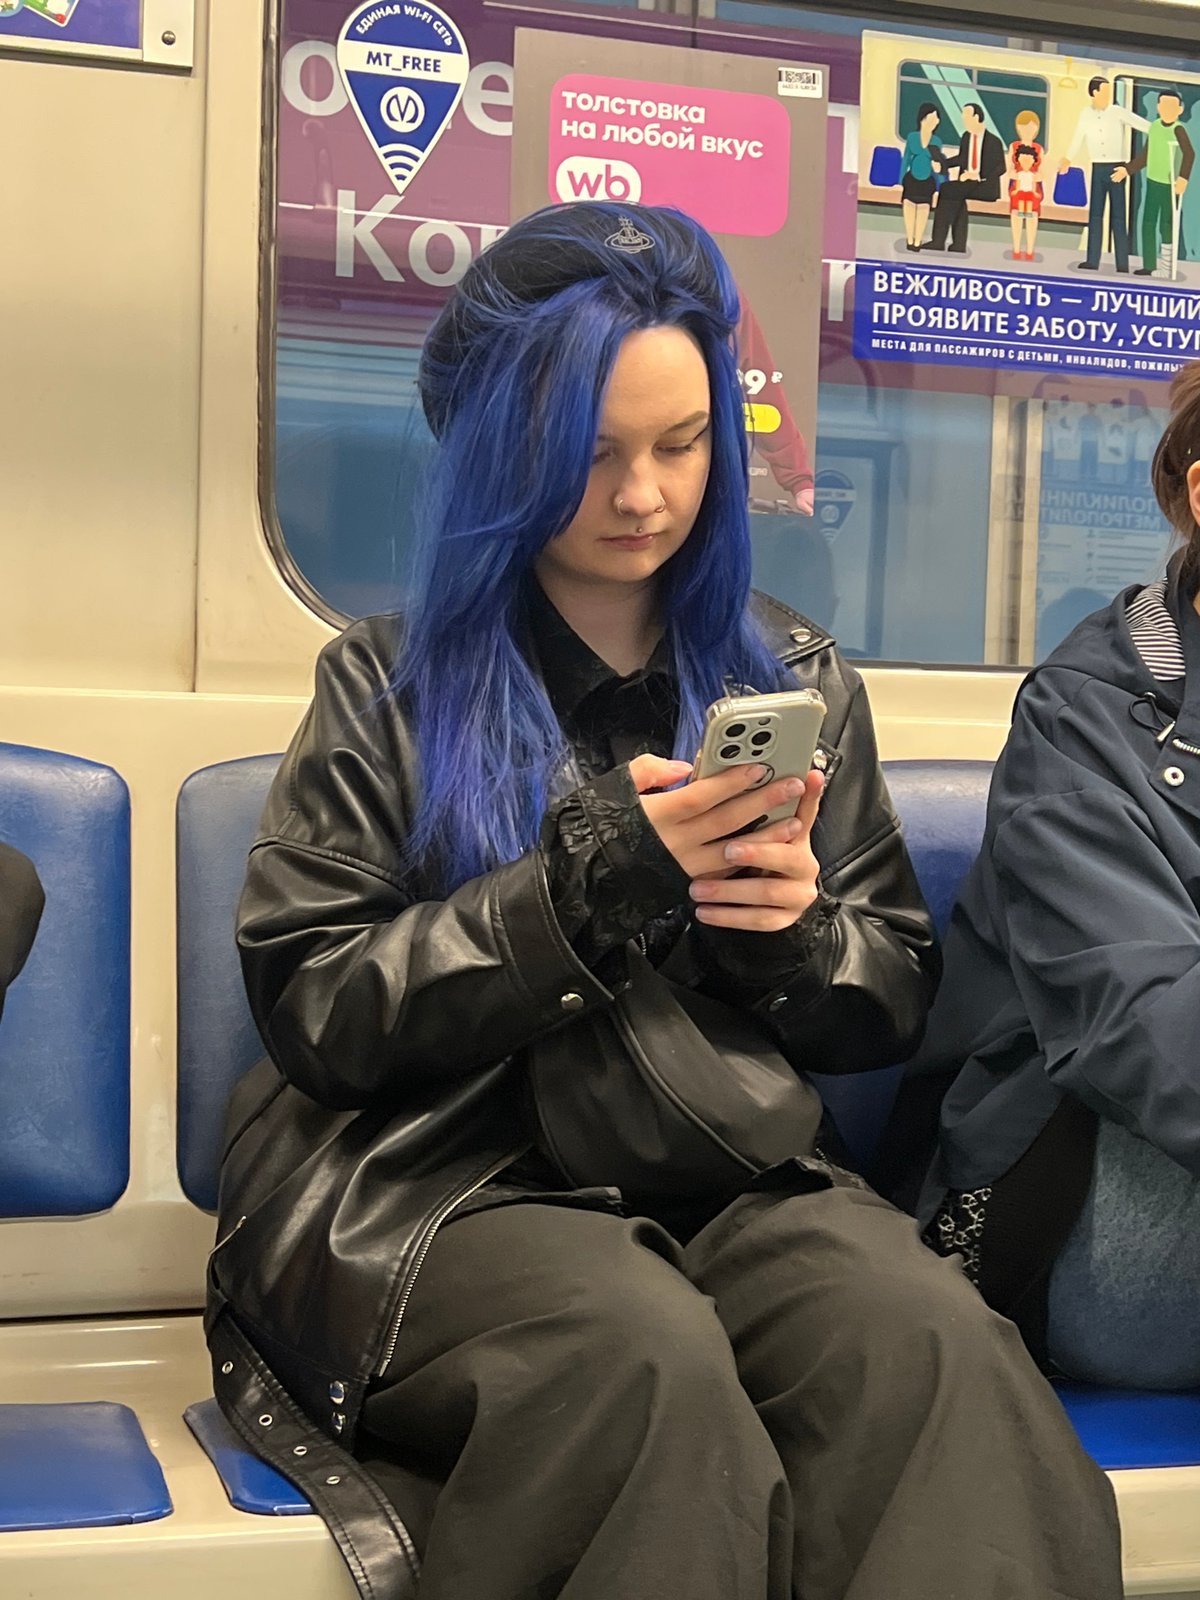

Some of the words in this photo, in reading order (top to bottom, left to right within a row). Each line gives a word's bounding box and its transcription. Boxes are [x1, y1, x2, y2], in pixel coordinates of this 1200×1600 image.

[355, 4, 401, 34] ЕДИНАЯ
[432, 20, 454, 46] СЕТЬ
[366, 51, 442, 73] MT_FREE
[561, 119, 597, 139] на
[602, 124, 696, 150] любой
[702, 134, 764, 160] вкус
[567, 164, 631, 200] wb
[873, 270, 1051, 307] ВЕЖЛИВОСТЬ
[1091, 290, 1200, 320] ЛУЧШИЙ
[872, 302, 1009, 334] ПРОЯВИТЕ
[871, 338, 907, 350] МЕСТА
[909, 341, 931, 353] ДЛЯ
[934, 343, 1005, 359] ПАССАЖИРОВ
[1008, 351, 1015, 359] С
